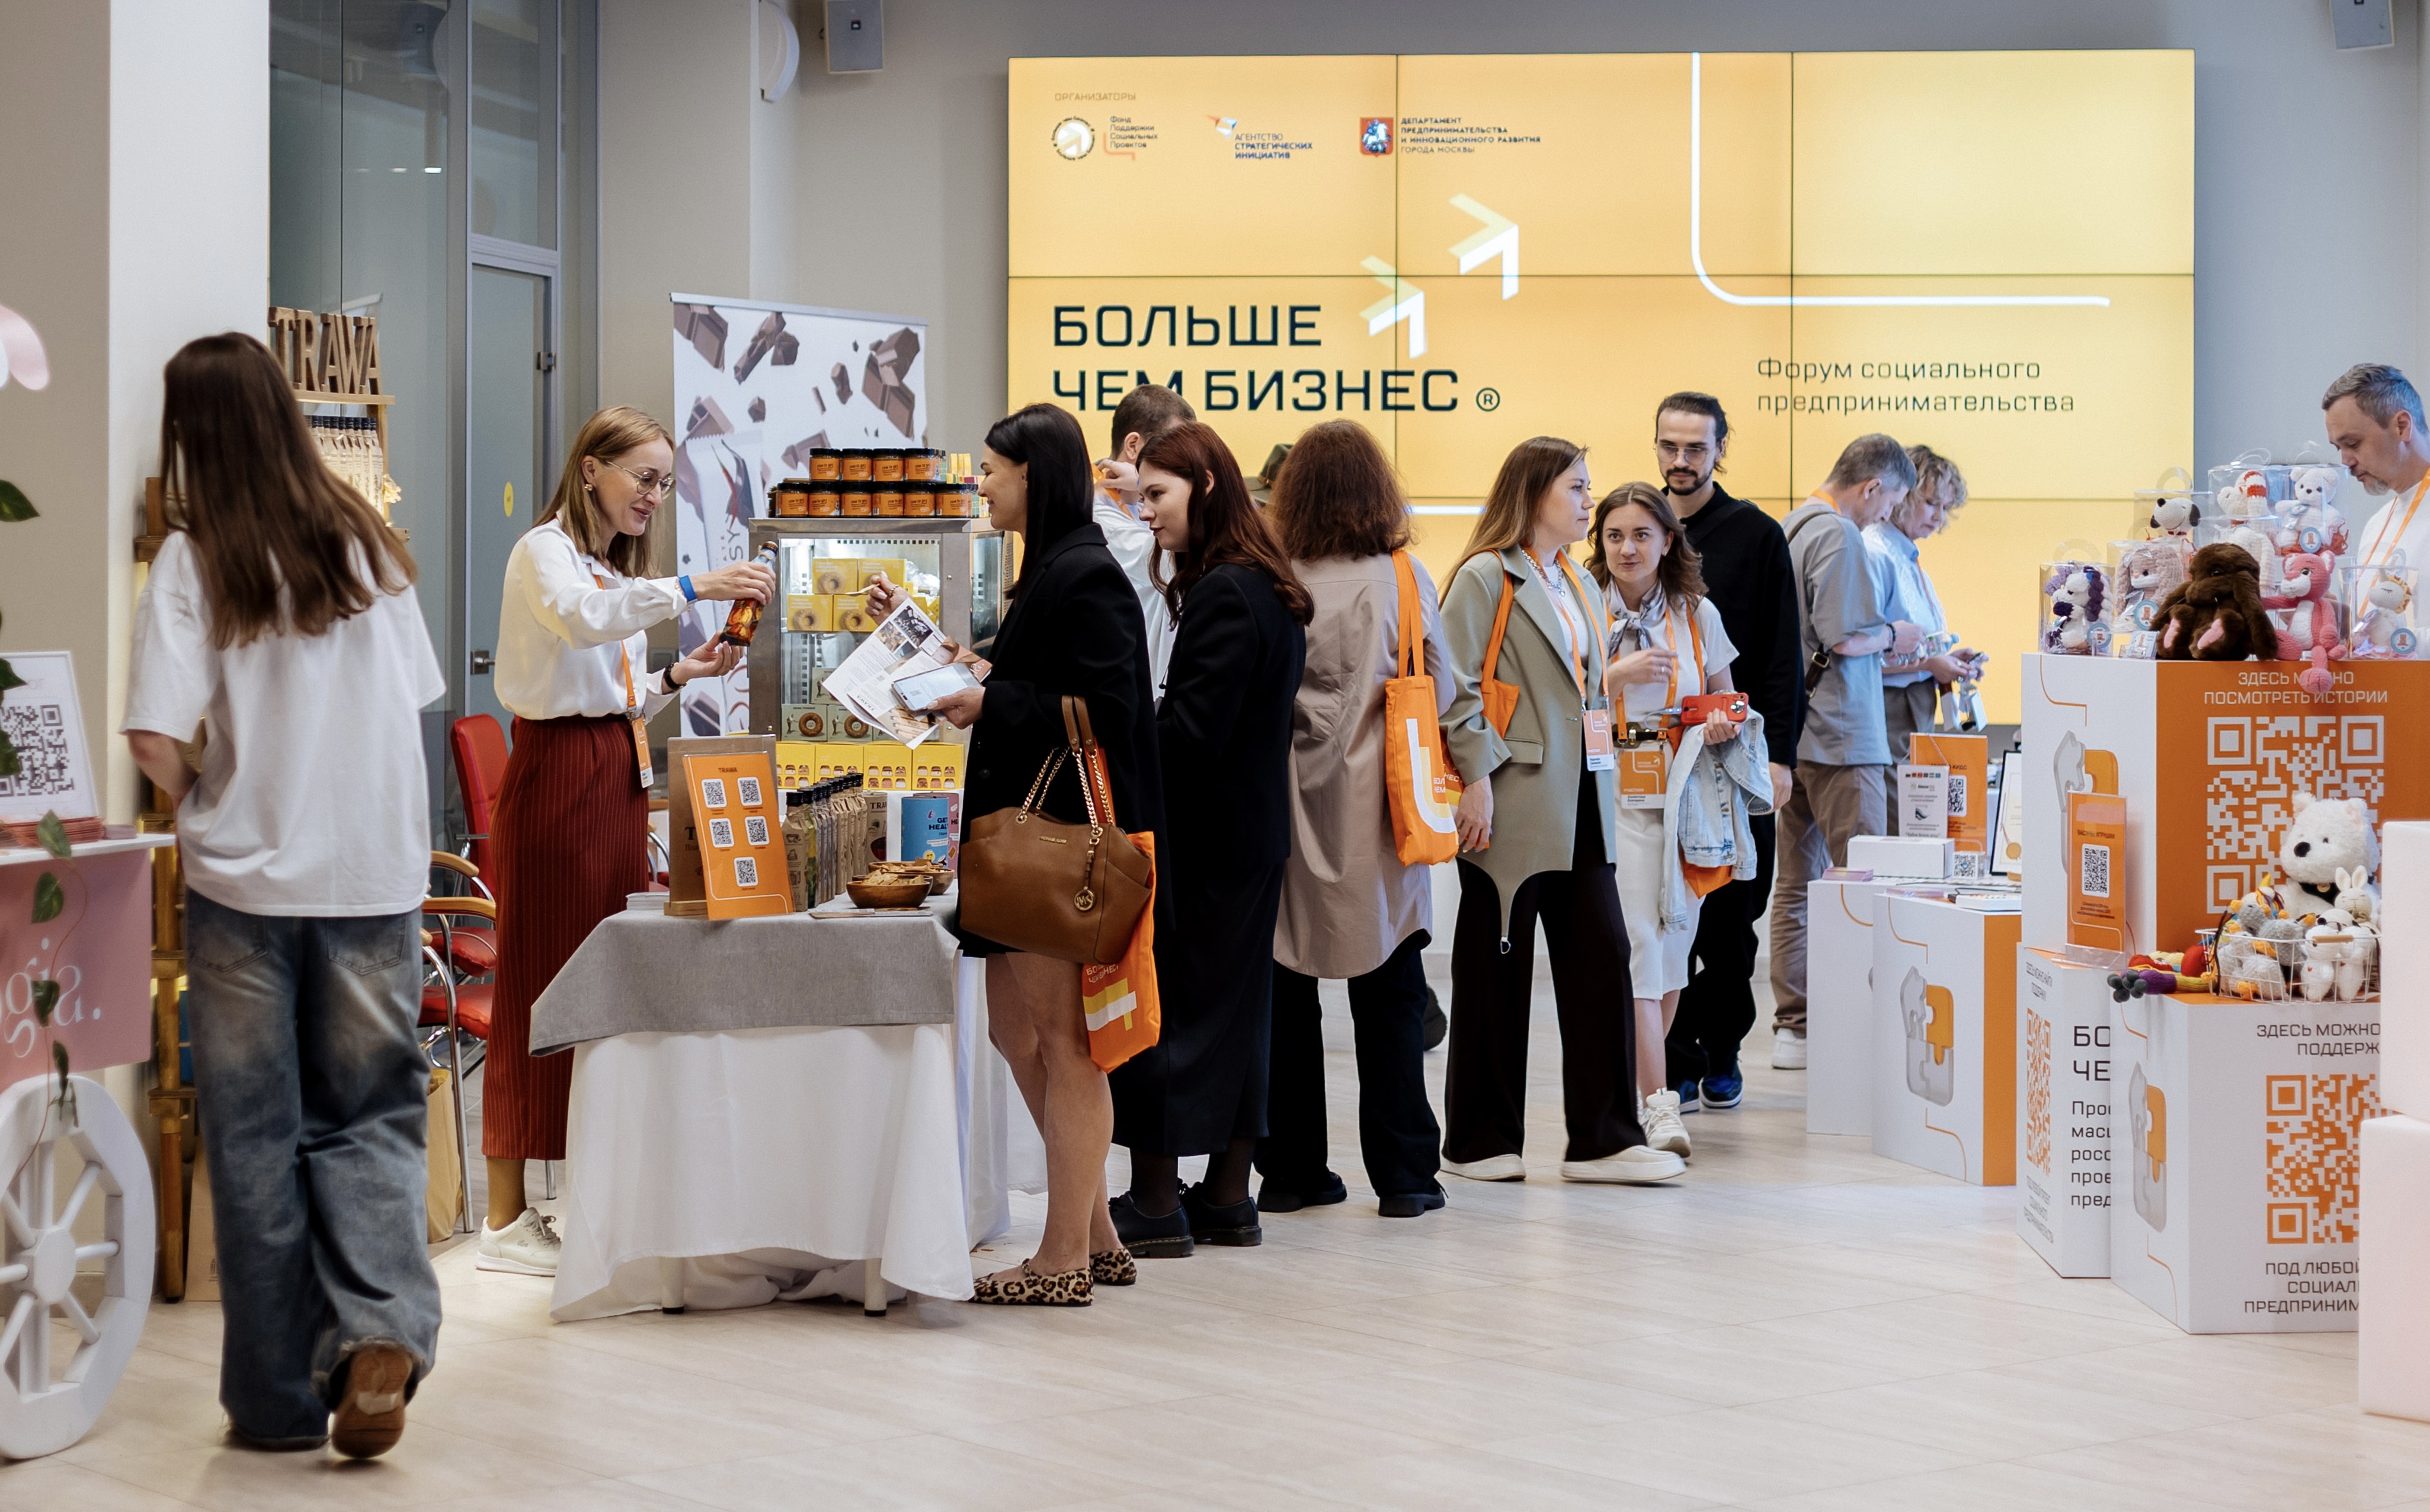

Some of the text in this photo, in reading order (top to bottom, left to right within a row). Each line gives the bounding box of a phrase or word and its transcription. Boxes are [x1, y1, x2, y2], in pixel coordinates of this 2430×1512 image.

[1054, 92, 1136, 101] ОРГАНИЗАТОРЫ
[1053, 305, 1323, 347] БОЛЬШЕ
[268, 306, 384, 396] TRAWA
[1757, 357, 2041, 383] Форум социального
[1205, 369, 1459, 412] БИЗНЕС
[1757, 394, 2074, 416] предпринимательства
[2238, 672, 2290, 686] ЗДЕСЬ
[2204, 690, 2388, 704] ПОСМОТРЕТЬ ИСТОРИИ
[2073, 1025, 2111, 1047] БО
[2256, 1023, 2381, 1038] ЗДЕСЬ МОЖНО
[2297, 1042, 2380, 1057] ПОДДЕРЖ
[2073, 1059, 2111, 1081] ЧЕ
[2072, 1100, 2111, 1119] Про
[2265, 1262, 2300, 1276] ПОД
[2287, 1280, 2359, 1294] СОЦИАЛ
[2244, 1299, 2359, 1314] ПРЕДПРИНИМ
